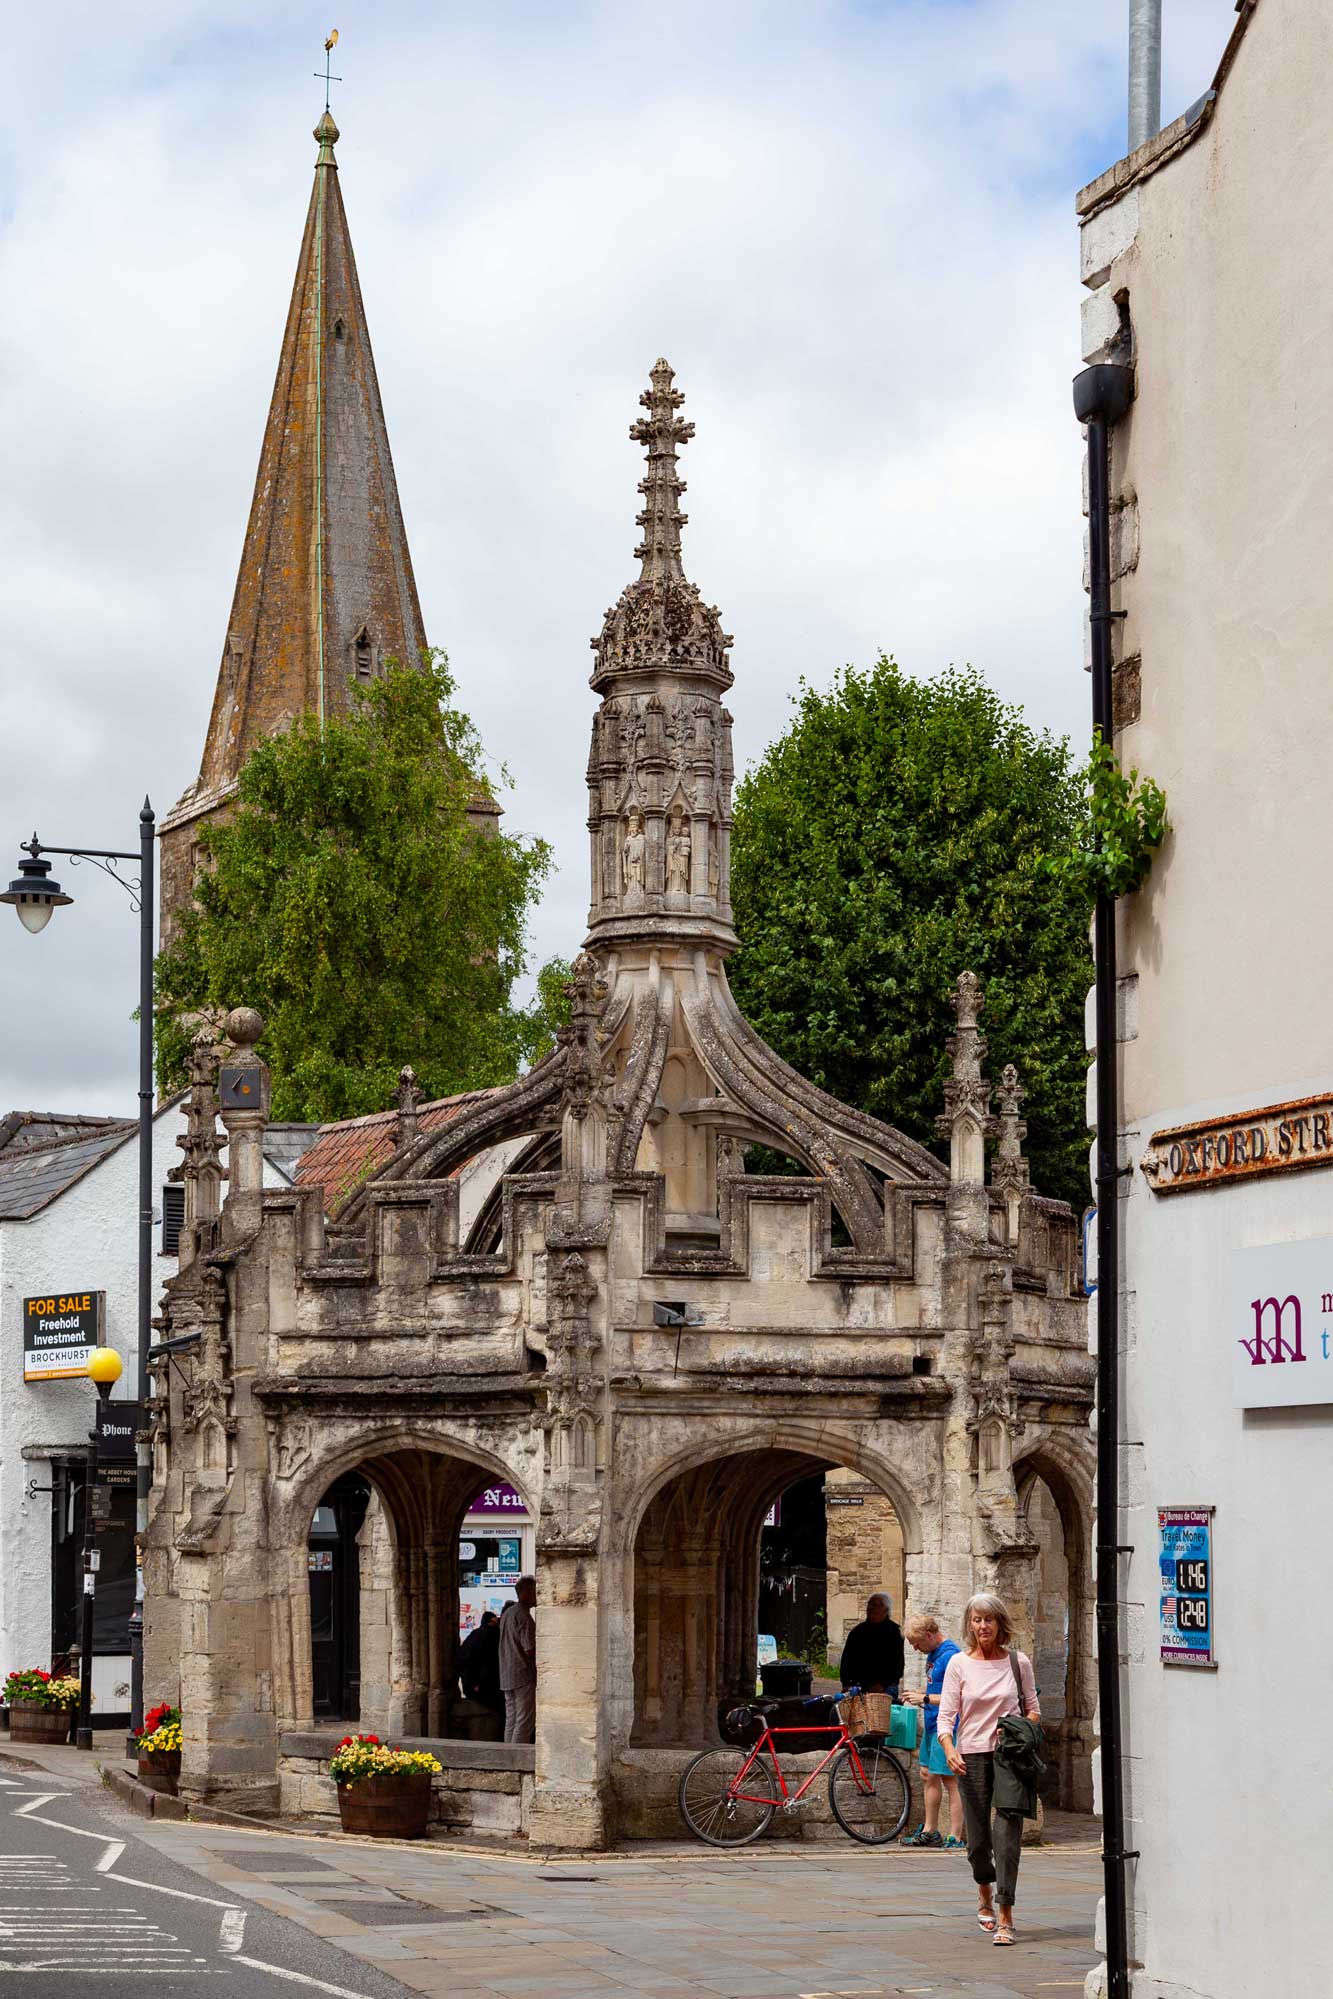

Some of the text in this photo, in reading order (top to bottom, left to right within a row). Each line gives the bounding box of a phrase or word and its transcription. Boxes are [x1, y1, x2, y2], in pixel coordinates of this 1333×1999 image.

[1170, 1112, 1333, 1176] OXFORD STR
[28, 1295, 91, 1316] FOR SALE
[39, 1316, 79, 1330] Freehold
[34, 1330, 86, 1346] Investment
[31, 1349, 90, 1363] BROCKHURST
[102, 1423, 132, 1437] Phone
[1168, 1511, 1208, 1523] Bureau de Change
[1161, 1529, 1205, 1546] Travel Money
[1163, 1615, 1175, 1623] USD
[1162, 1634, 1208, 1647] 0% COMMISSION
